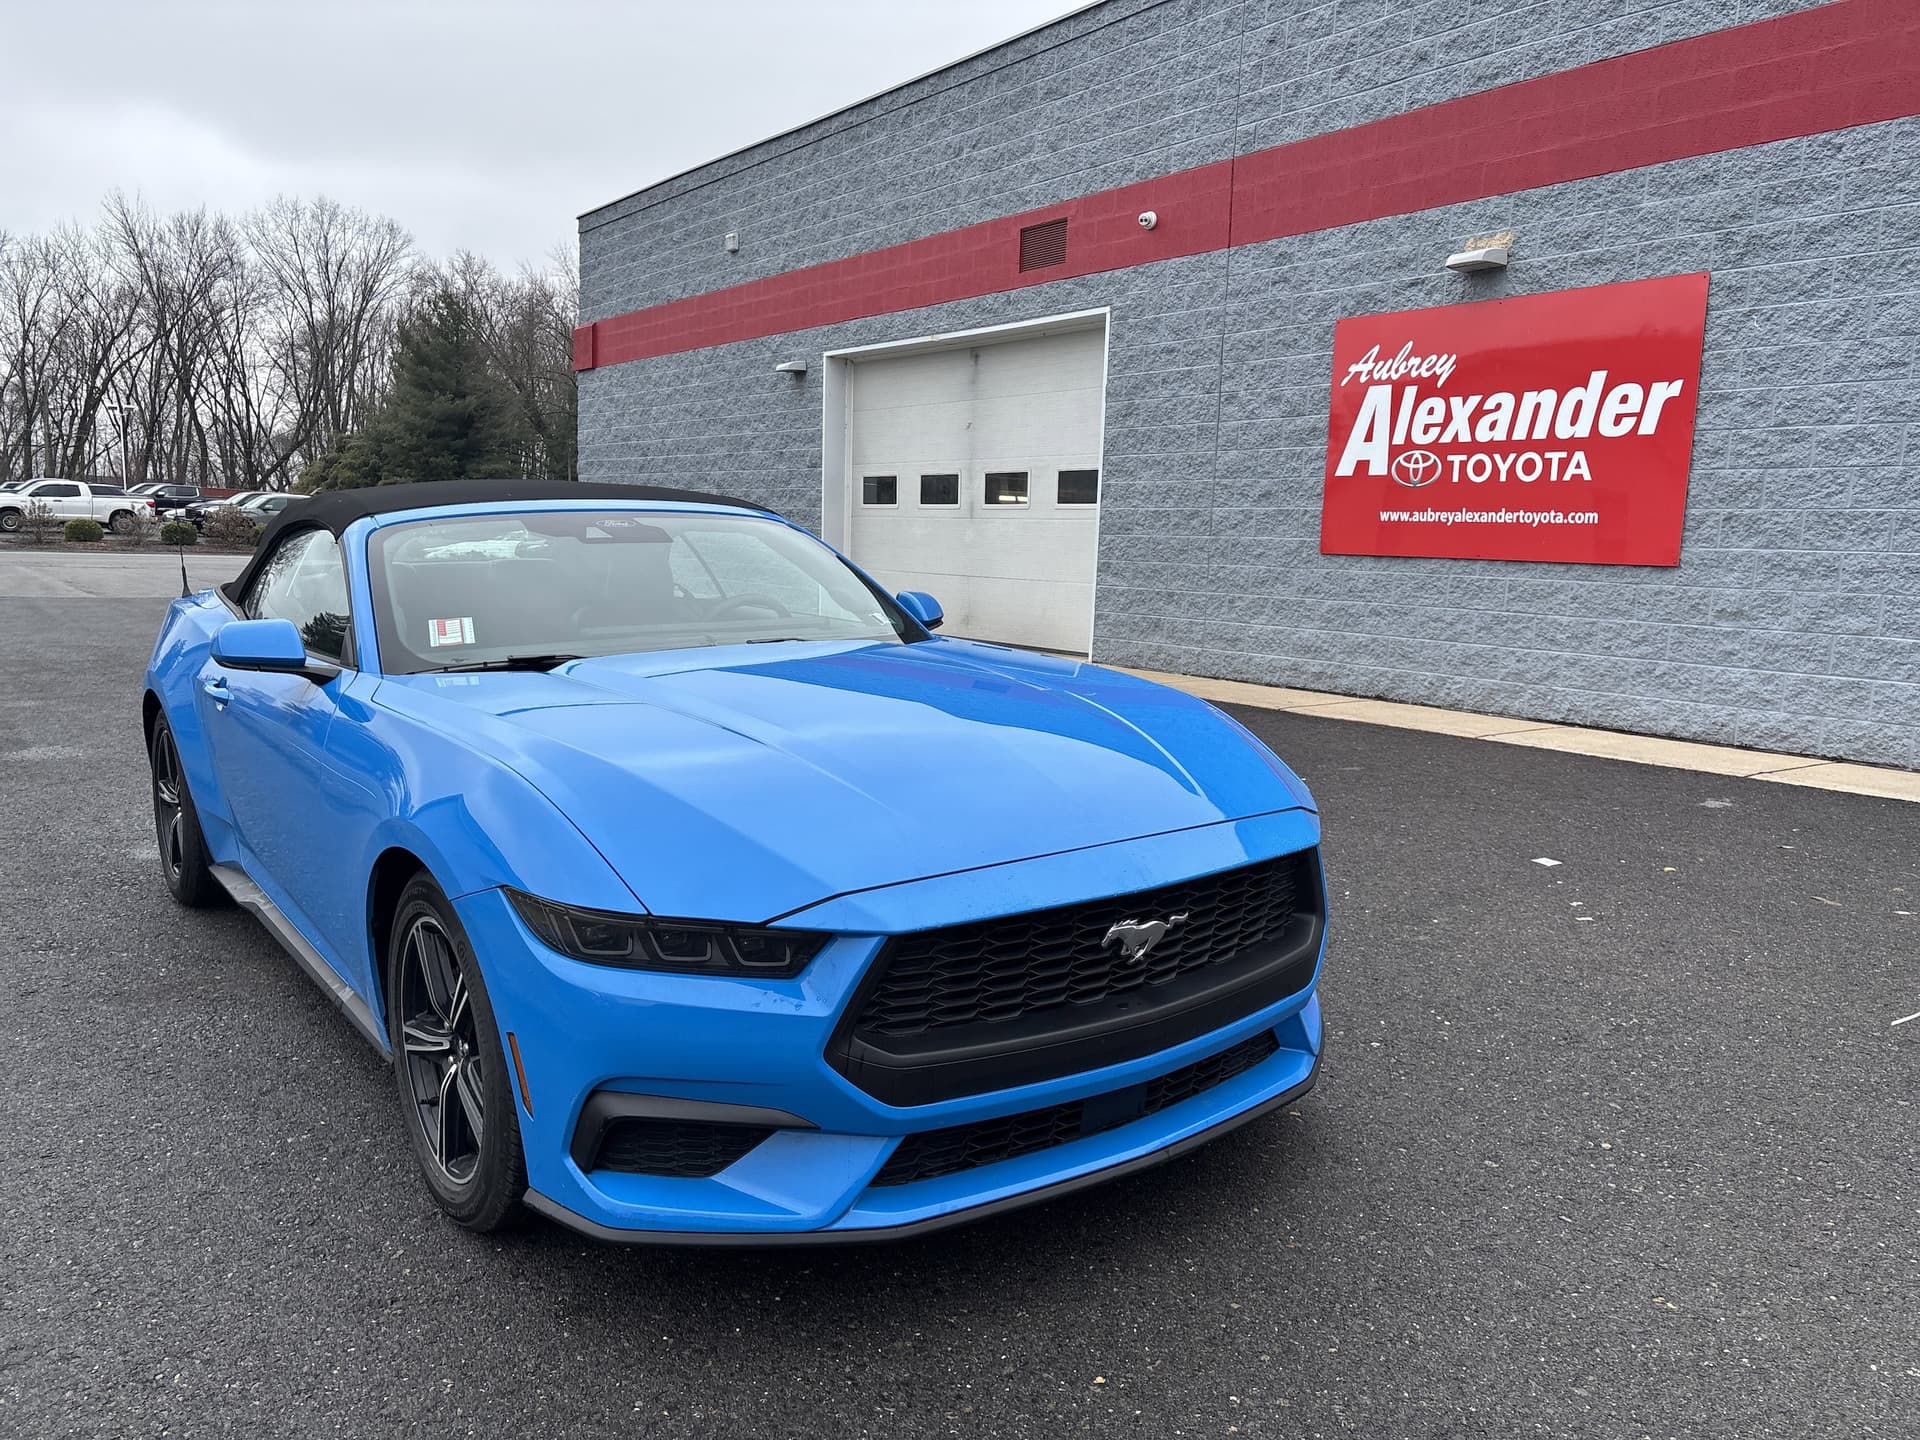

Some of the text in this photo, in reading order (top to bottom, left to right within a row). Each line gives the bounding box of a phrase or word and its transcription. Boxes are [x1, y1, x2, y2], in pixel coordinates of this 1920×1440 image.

[1341, 340, 1457, 388] Aubrey
[1335, 370, 1684, 477] Alexander
[1447, 451, 1592, 483] TOYOTA
[1379, 508, 1599, 527] www.aubreyalexandertoyota.com
